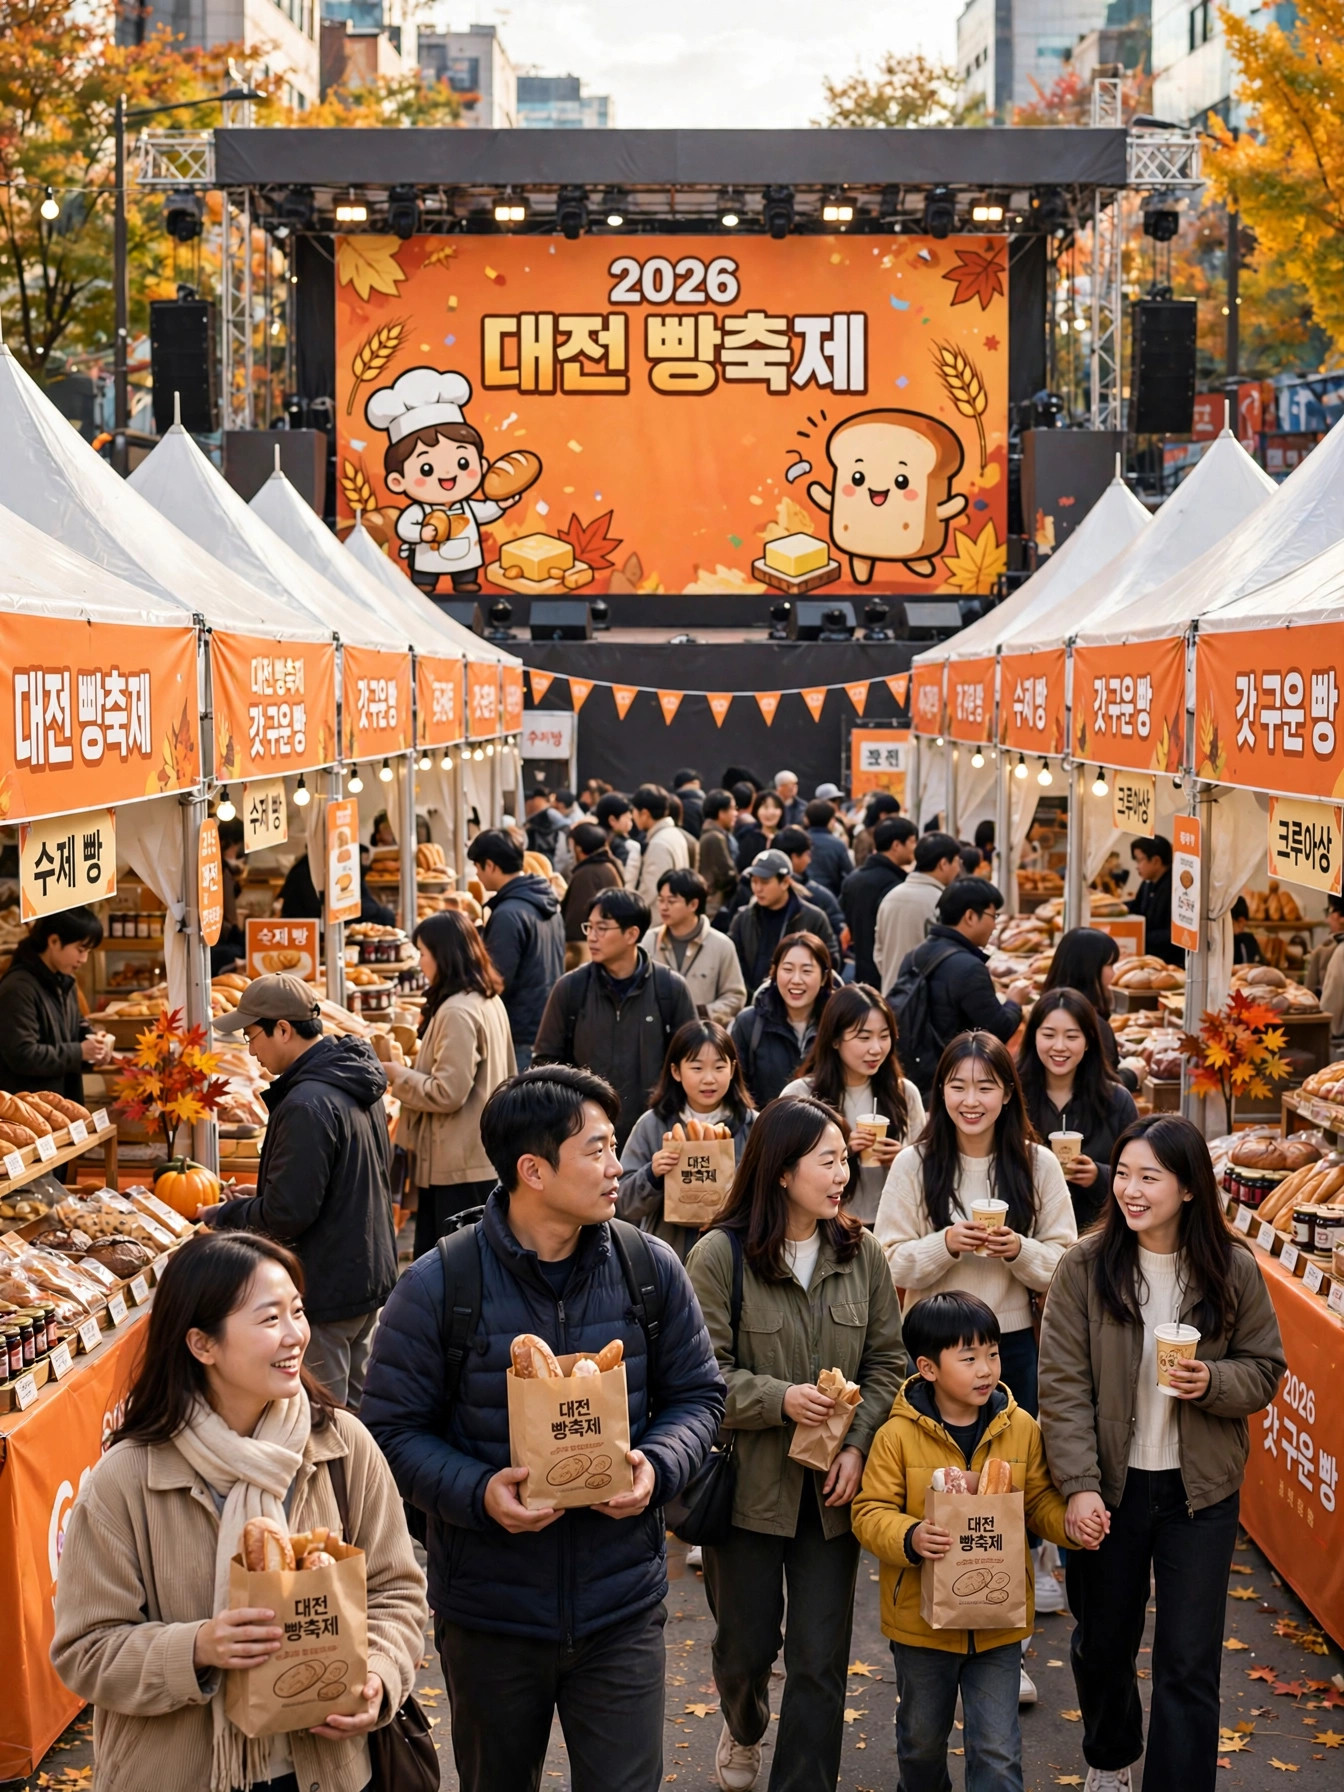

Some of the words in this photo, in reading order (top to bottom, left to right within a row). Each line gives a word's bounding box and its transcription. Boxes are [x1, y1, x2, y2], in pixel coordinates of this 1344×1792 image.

[609, 257, 739, 304] 2026
[482, 313, 629, 395] 대전
[645, 311, 868, 395] 빵축제
[14, 670, 73, 766] 대전
[77, 669, 152, 760] 빵축제
[250, 794, 269, 835] 수제
[272, 793, 282, 830] 빵
[1117, 786, 1150, 824] 크루아상
[33, 834, 76, 897] 수제
[82, 829, 103, 884] 빵
[1277, 820, 1332, 874] 크루아상
[681, 1169, 717, 1184] 빵축제
[687, 1155, 710, 1169] 대전
[559, 1398, 591, 1418] 대전
[1283, 1368, 1316, 1425] 2026
[551, 1417, 601, 1440] 빵축제
[967, 1516, 995, 1533] 대전
[959, 1533, 1003, 1552] 빵축제
[294, 1595, 328, 1617] 대전
[284, 1615, 339, 1642] 빵축제
